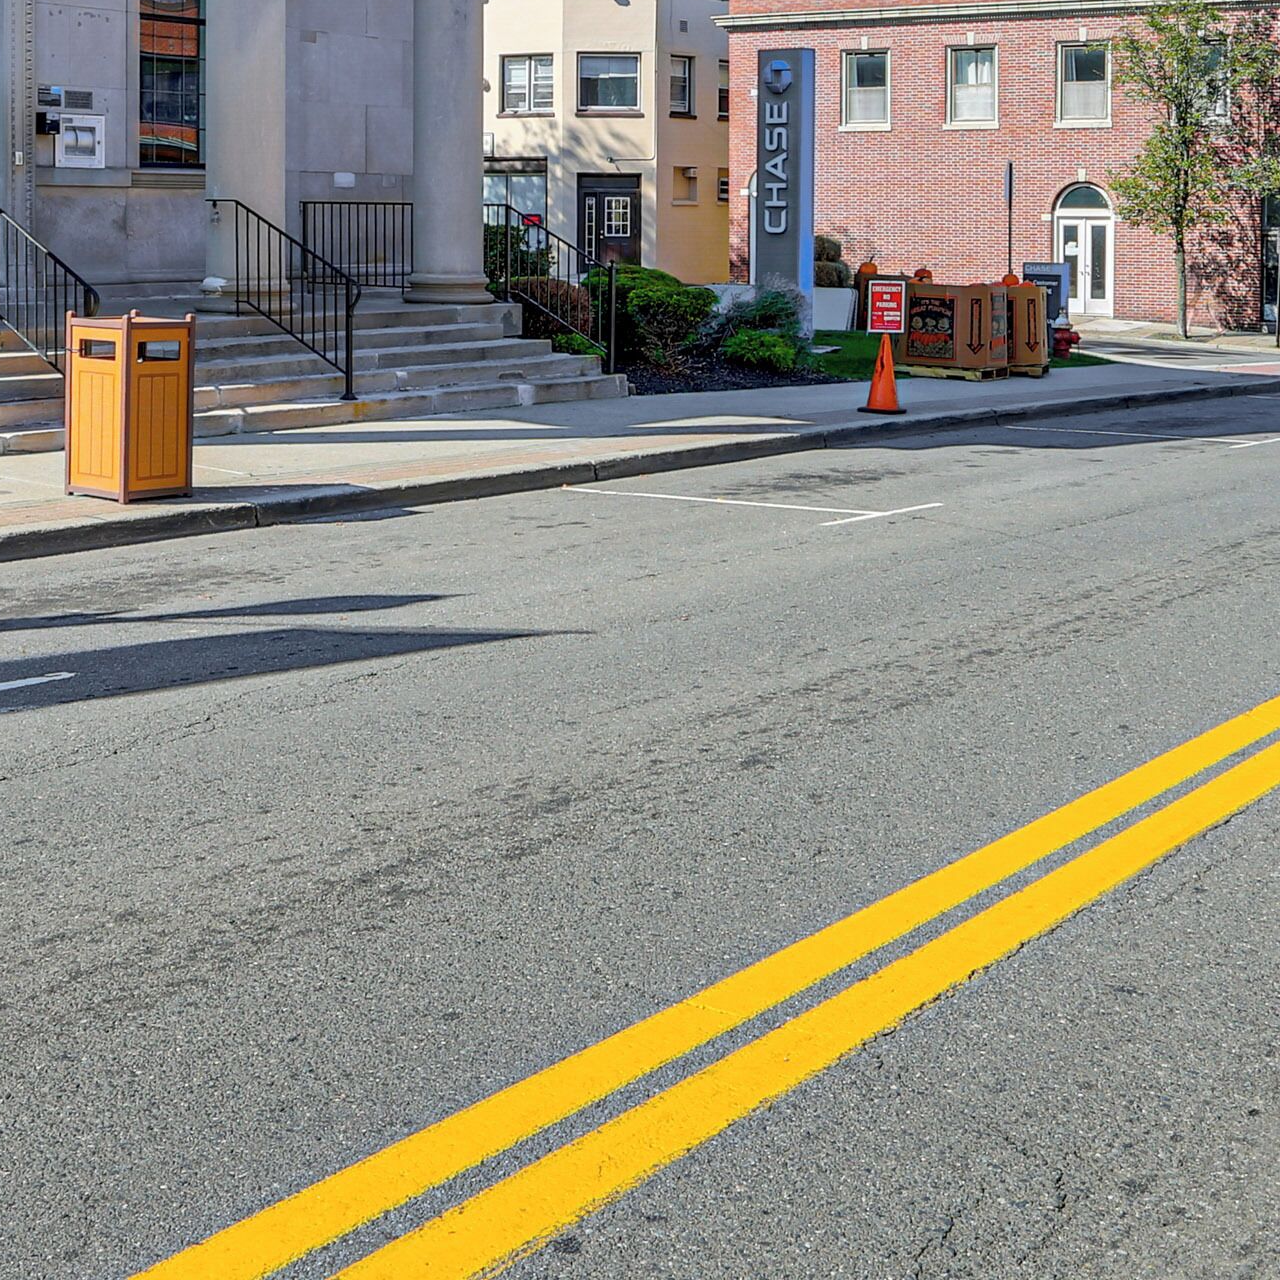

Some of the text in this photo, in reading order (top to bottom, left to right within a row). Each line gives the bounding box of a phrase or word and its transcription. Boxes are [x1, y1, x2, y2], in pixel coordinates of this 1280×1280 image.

[763, 100, 788, 234] CHASE
[1024, 264, 1051, 273] CHASE
[876, 301, 898, 309] PARKING
